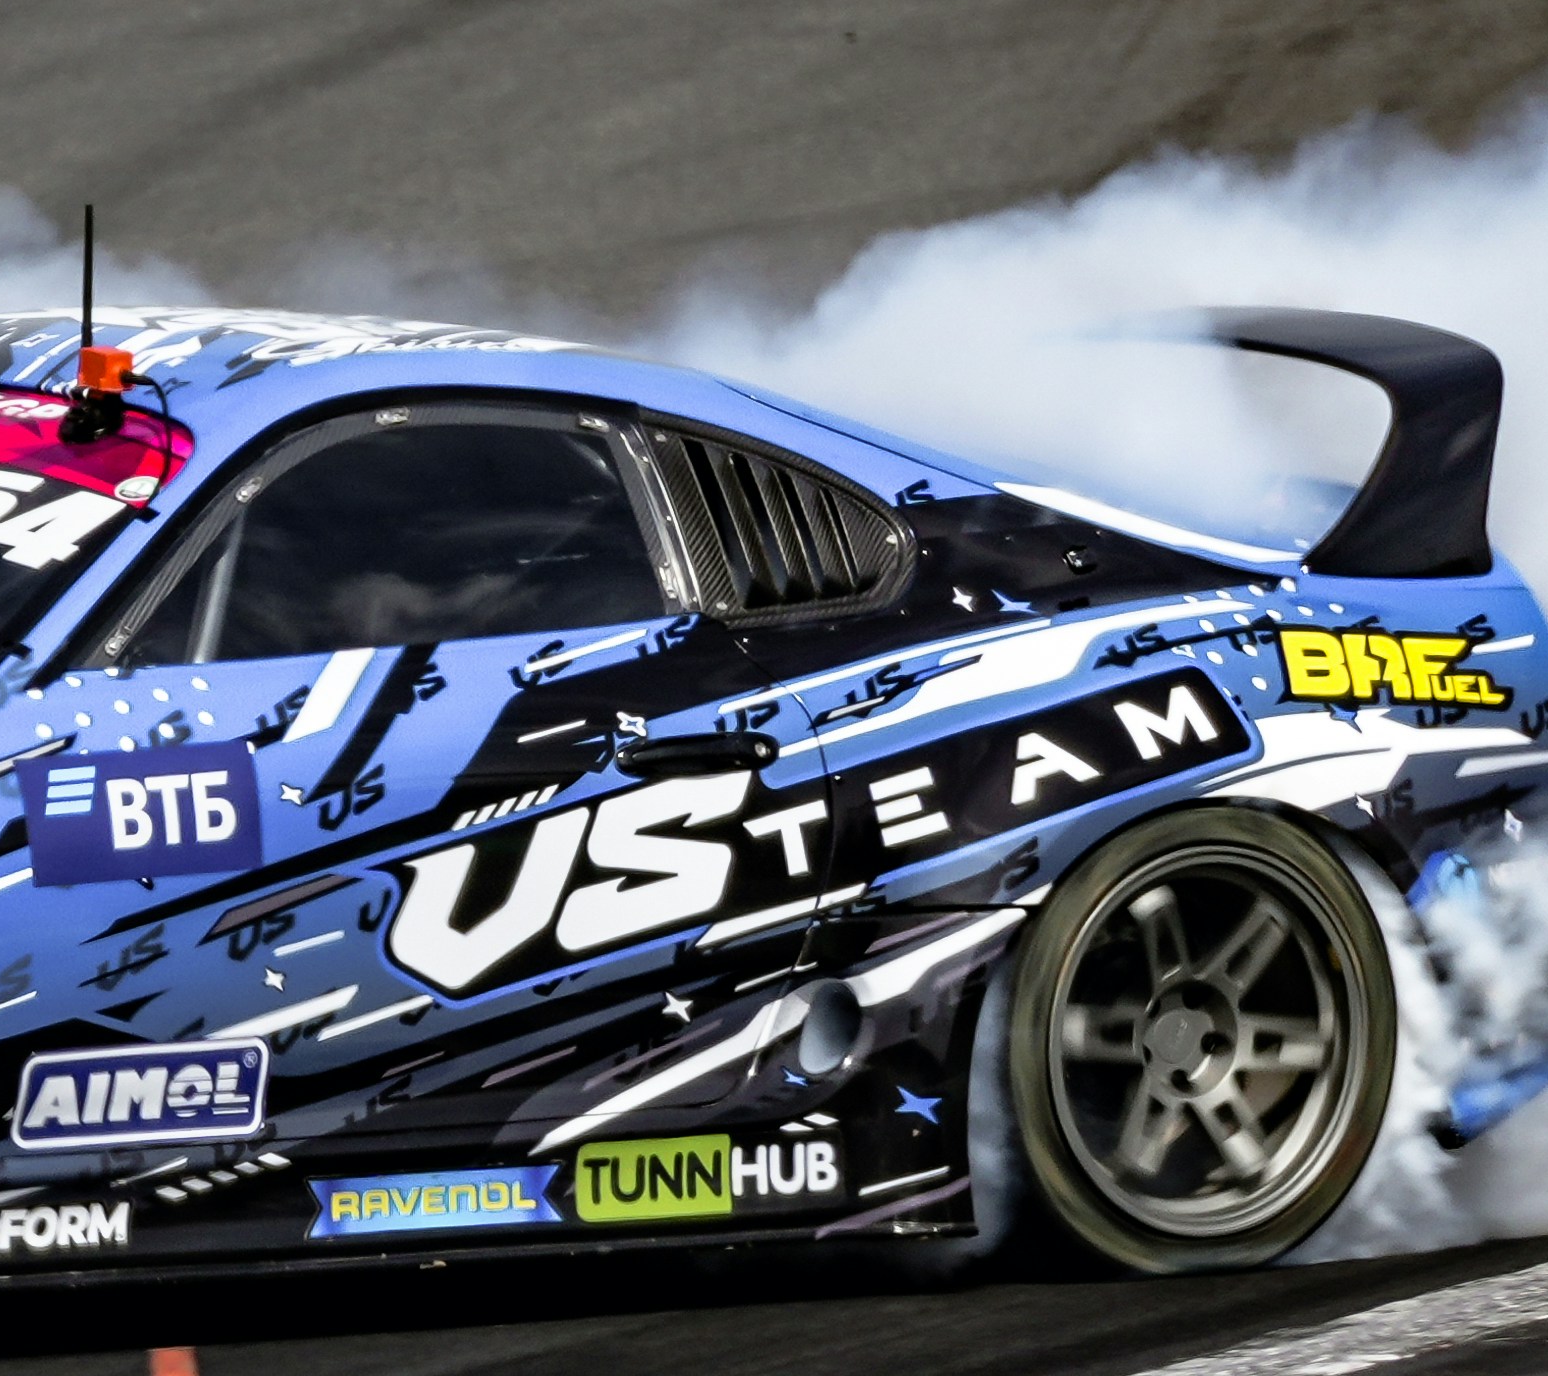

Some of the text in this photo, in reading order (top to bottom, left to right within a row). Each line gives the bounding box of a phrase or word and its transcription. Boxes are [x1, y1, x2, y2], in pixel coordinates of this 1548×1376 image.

[106, 770, 238, 851] ВТБ
[389, 684, 1218, 991] US TEAM
[23, 1061, 252, 1129] AIMOL
[330, 1180, 538, 1223] RAVENOL
